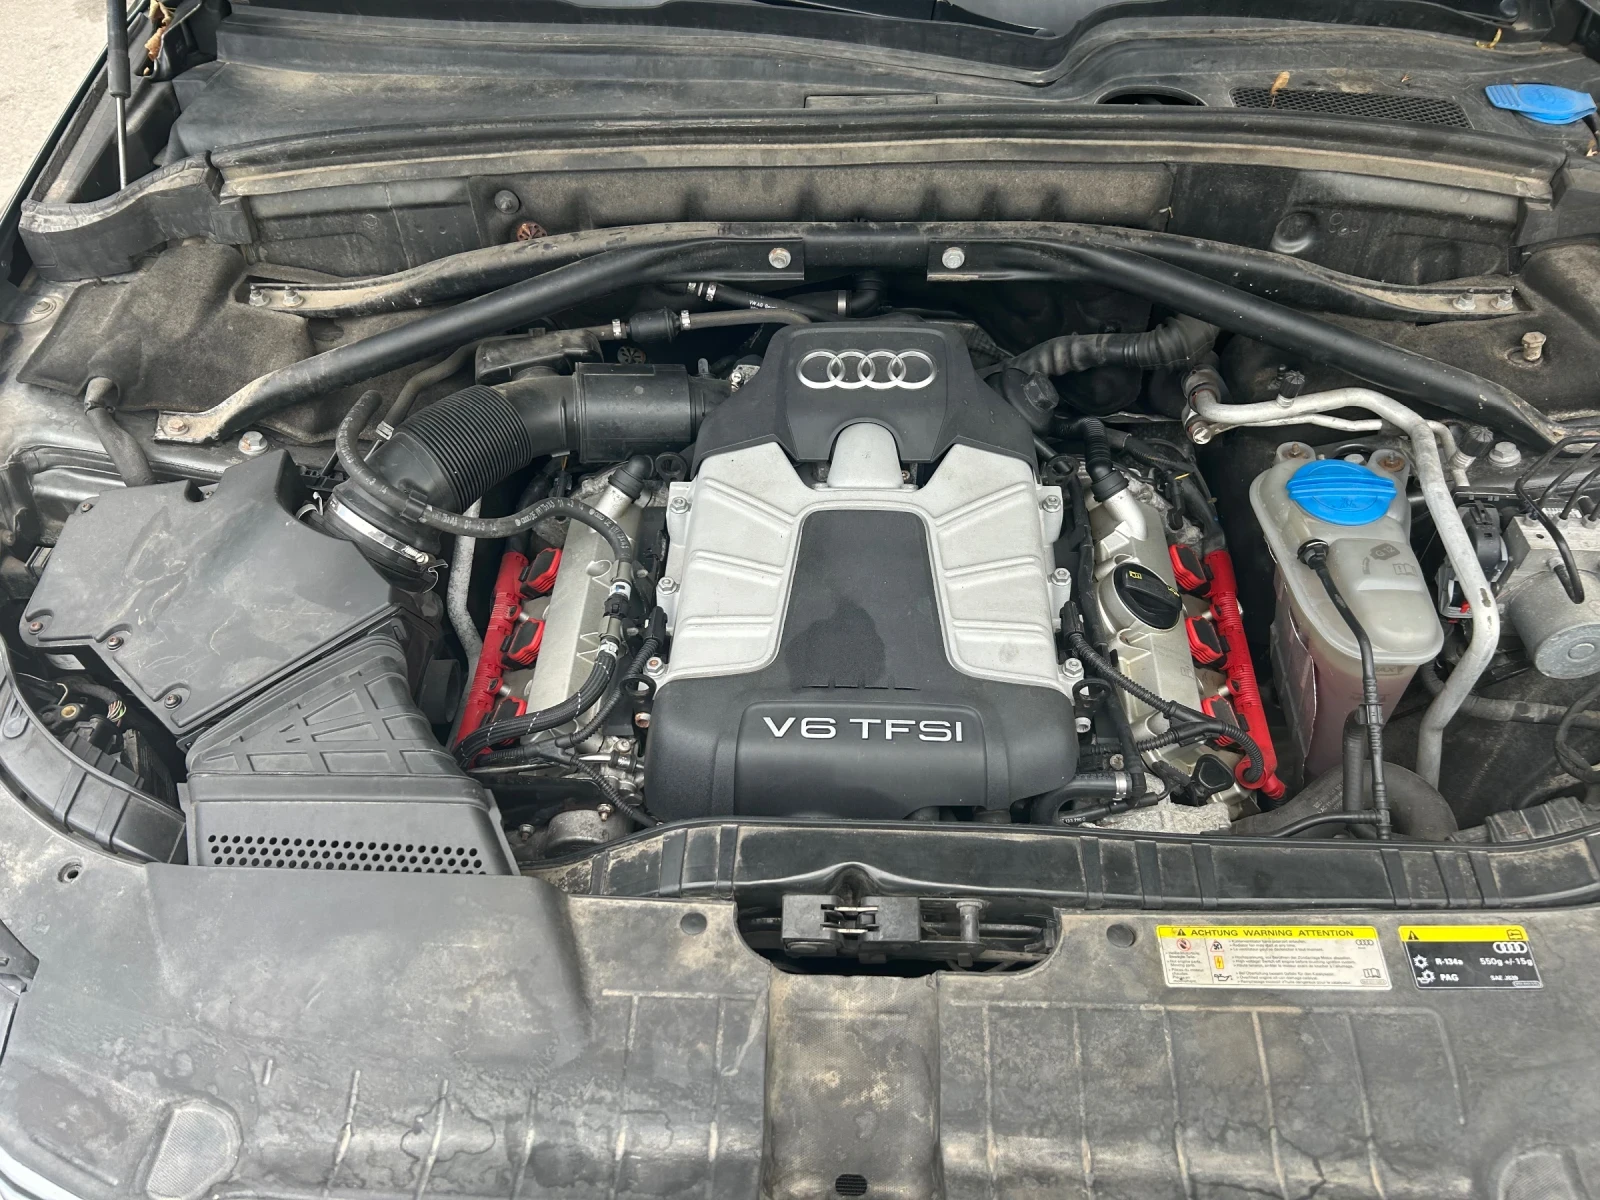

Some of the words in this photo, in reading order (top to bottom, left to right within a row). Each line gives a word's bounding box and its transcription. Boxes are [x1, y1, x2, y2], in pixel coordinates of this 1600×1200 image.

[763, 717, 837, 739] V6
[849, 718, 963, 742] TFSI
[1191, 929, 1238, 937] ACHTUNG
[1243, 929, 1293, 937] WARNING
[1298, 929, 1354, 937] ATTENTION
[1434, 957, 1464, 966] R-134a
[1479, 957, 1503, 967] 550g
[1440, 973, 1459, 982] PAG
